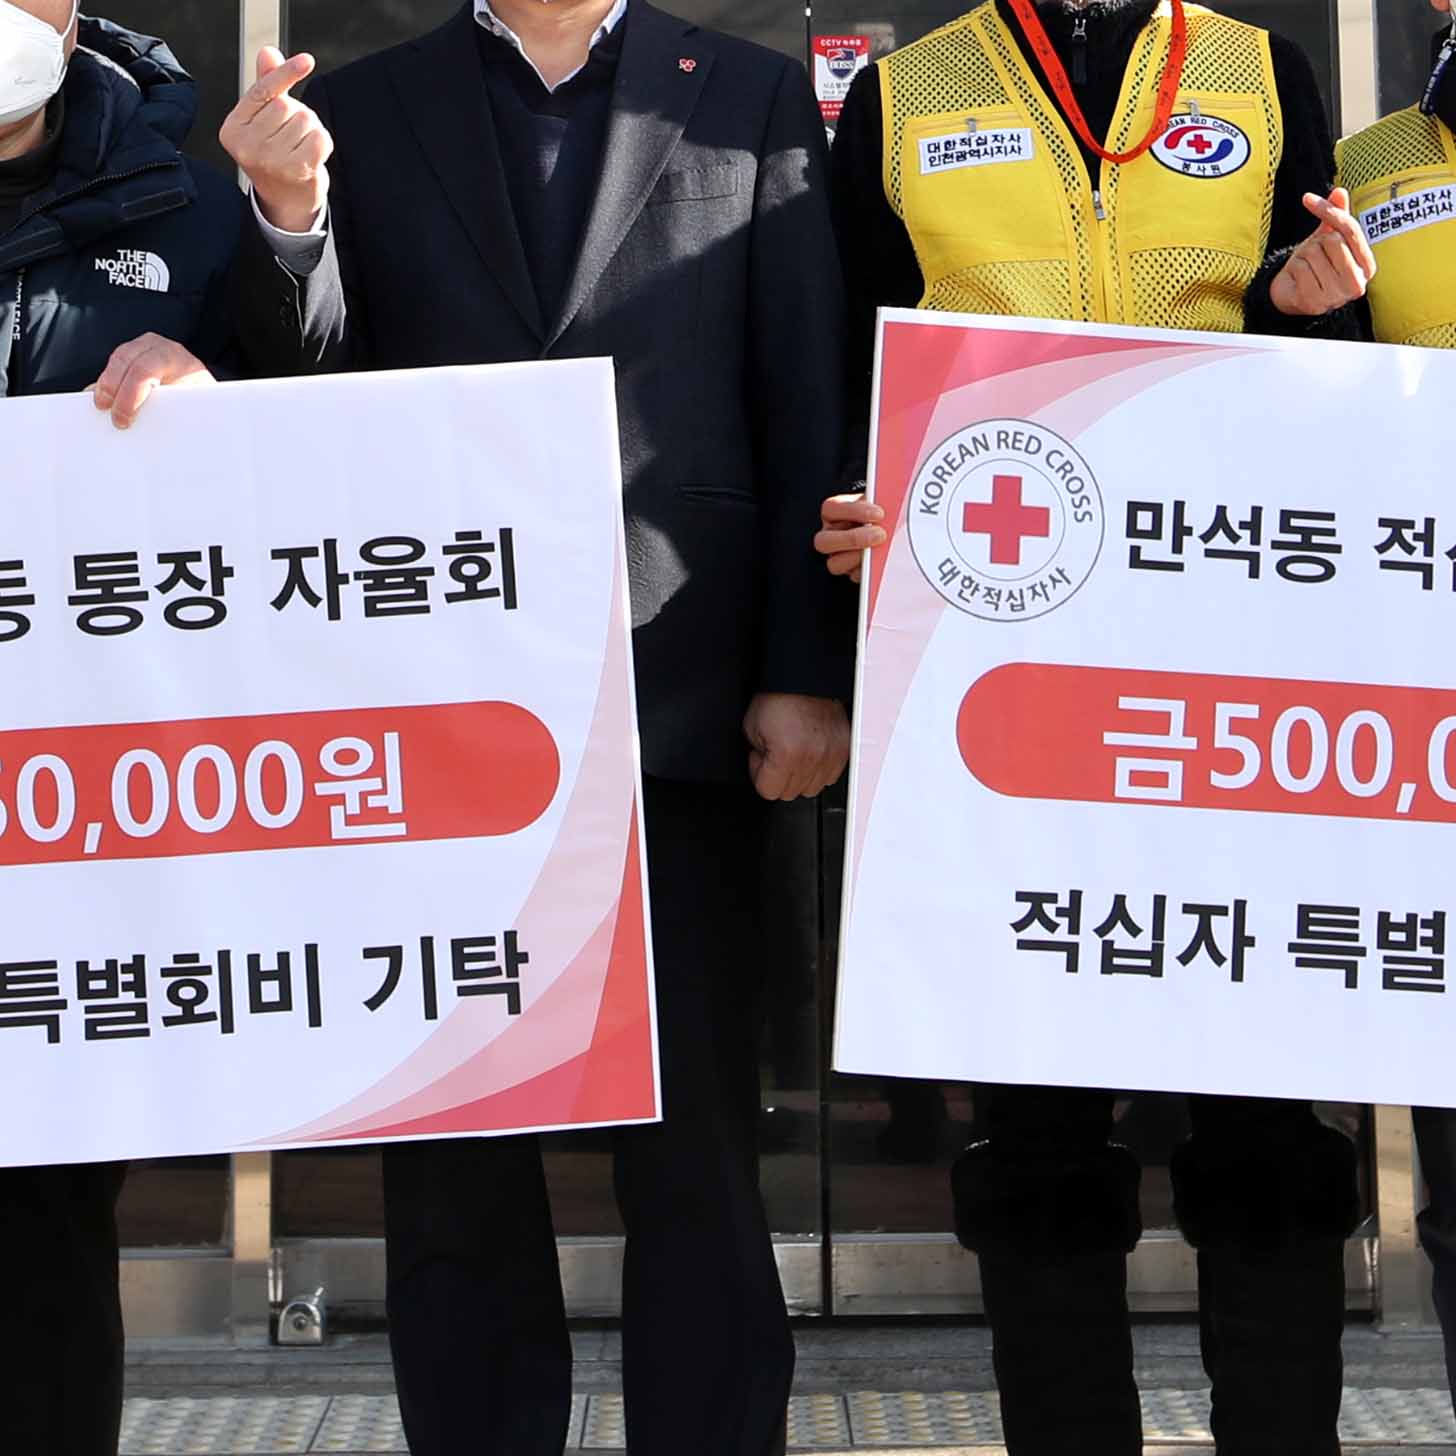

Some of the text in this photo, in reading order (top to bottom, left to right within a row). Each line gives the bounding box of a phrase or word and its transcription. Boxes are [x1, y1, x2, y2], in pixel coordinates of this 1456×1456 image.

[1190, 117, 1207, 125] RED
[1212, 120, 1240, 139] CROSS
[95, 258, 145, 276] NORTH
[108, 272, 145, 288] FACE
[117, 249, 145, 262] THE
[920, 430, 1093, 523] KOREAN RED CROSS
[1125, 500, 1342, 584] 만석동
[67, 545, 234, 636] 통장
[270, 527, 518, 621] 자율회
[938, 558, 1073, 613] 대한적십자사
[1010, 889, 1256, 983] 적십자
[362, 930, 529, 1021] 기탁
